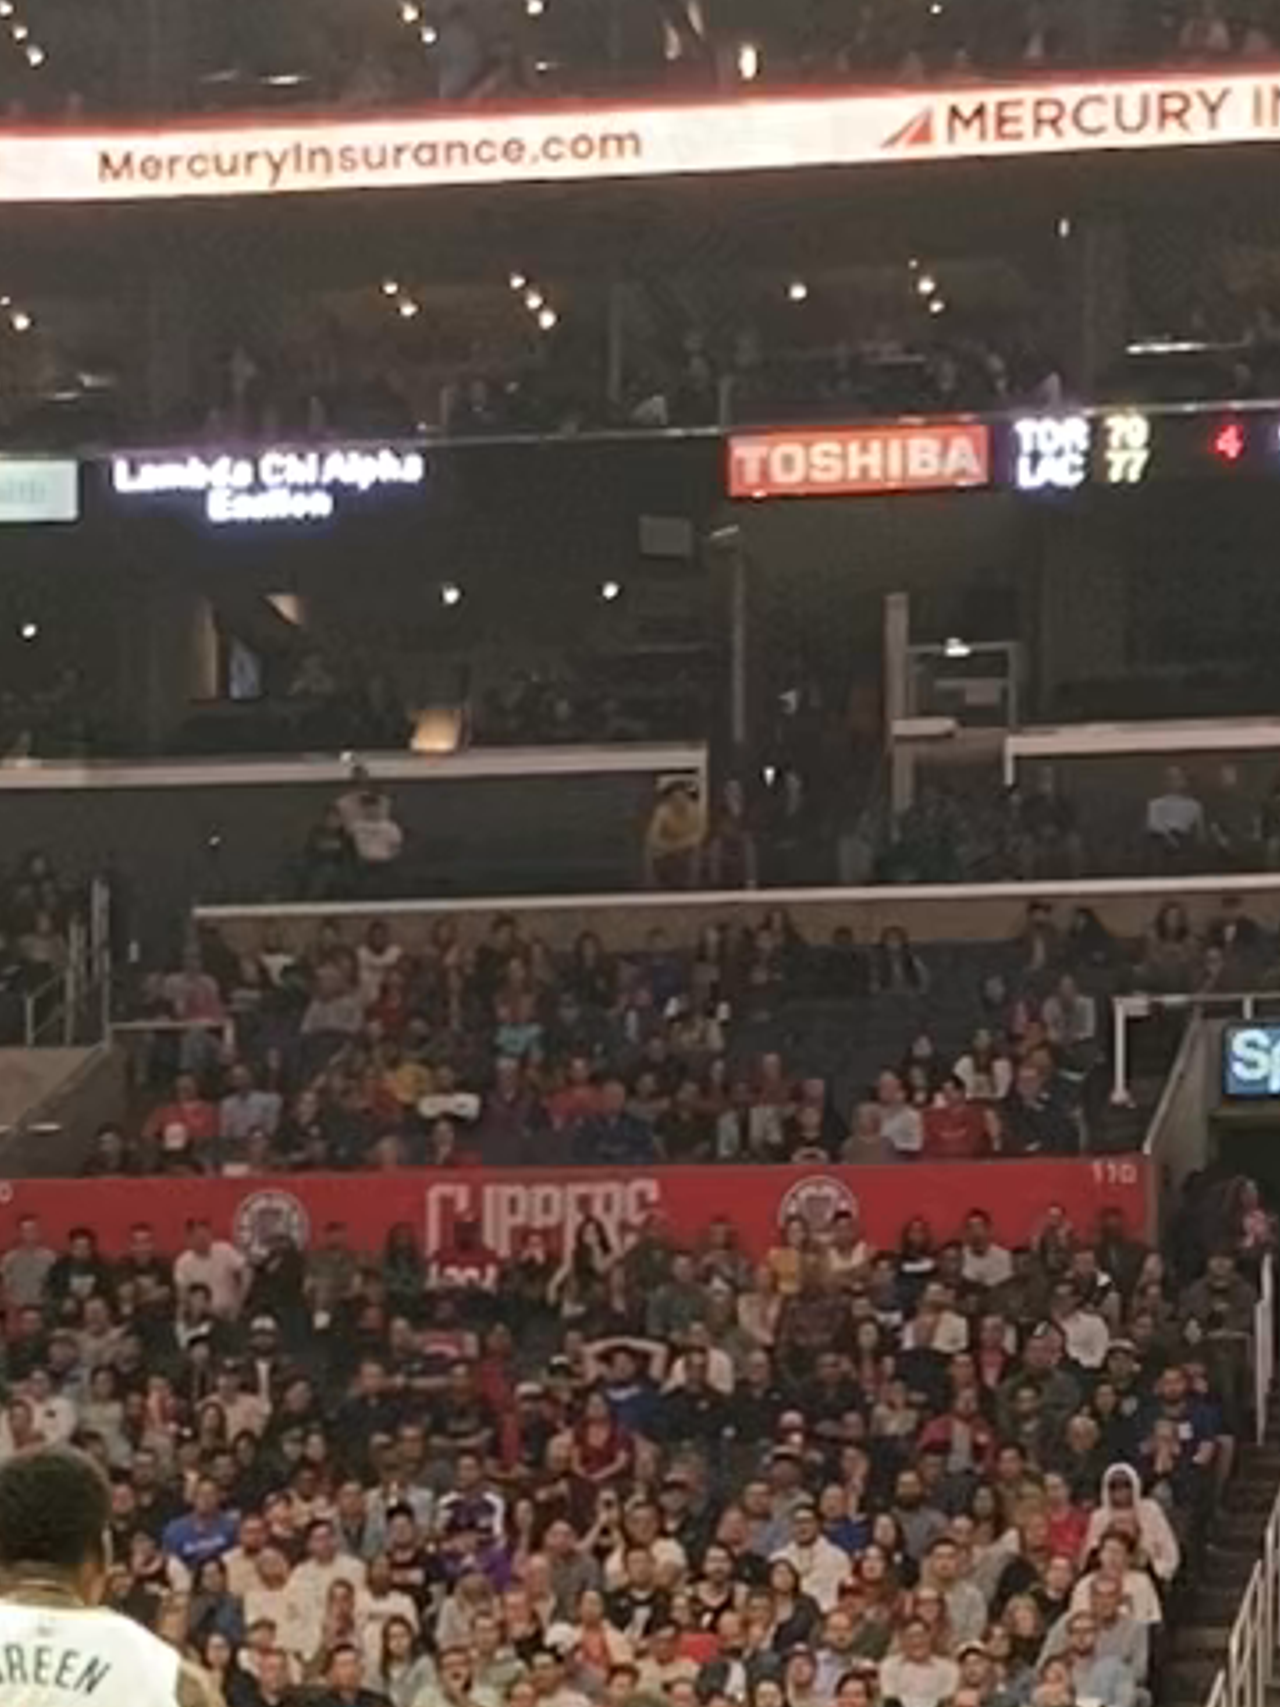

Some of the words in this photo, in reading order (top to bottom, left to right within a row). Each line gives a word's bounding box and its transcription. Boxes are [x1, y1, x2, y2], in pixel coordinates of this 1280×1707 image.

[945, 87, 1233, 144] MERCURY
[98, 127, 642, 186] MercuryInsurance.com
[732, 432, 984, 484] TOSHIBA
[1105, 449, 1150, 484] 77
[1217, 425, 1243, 459] 4
